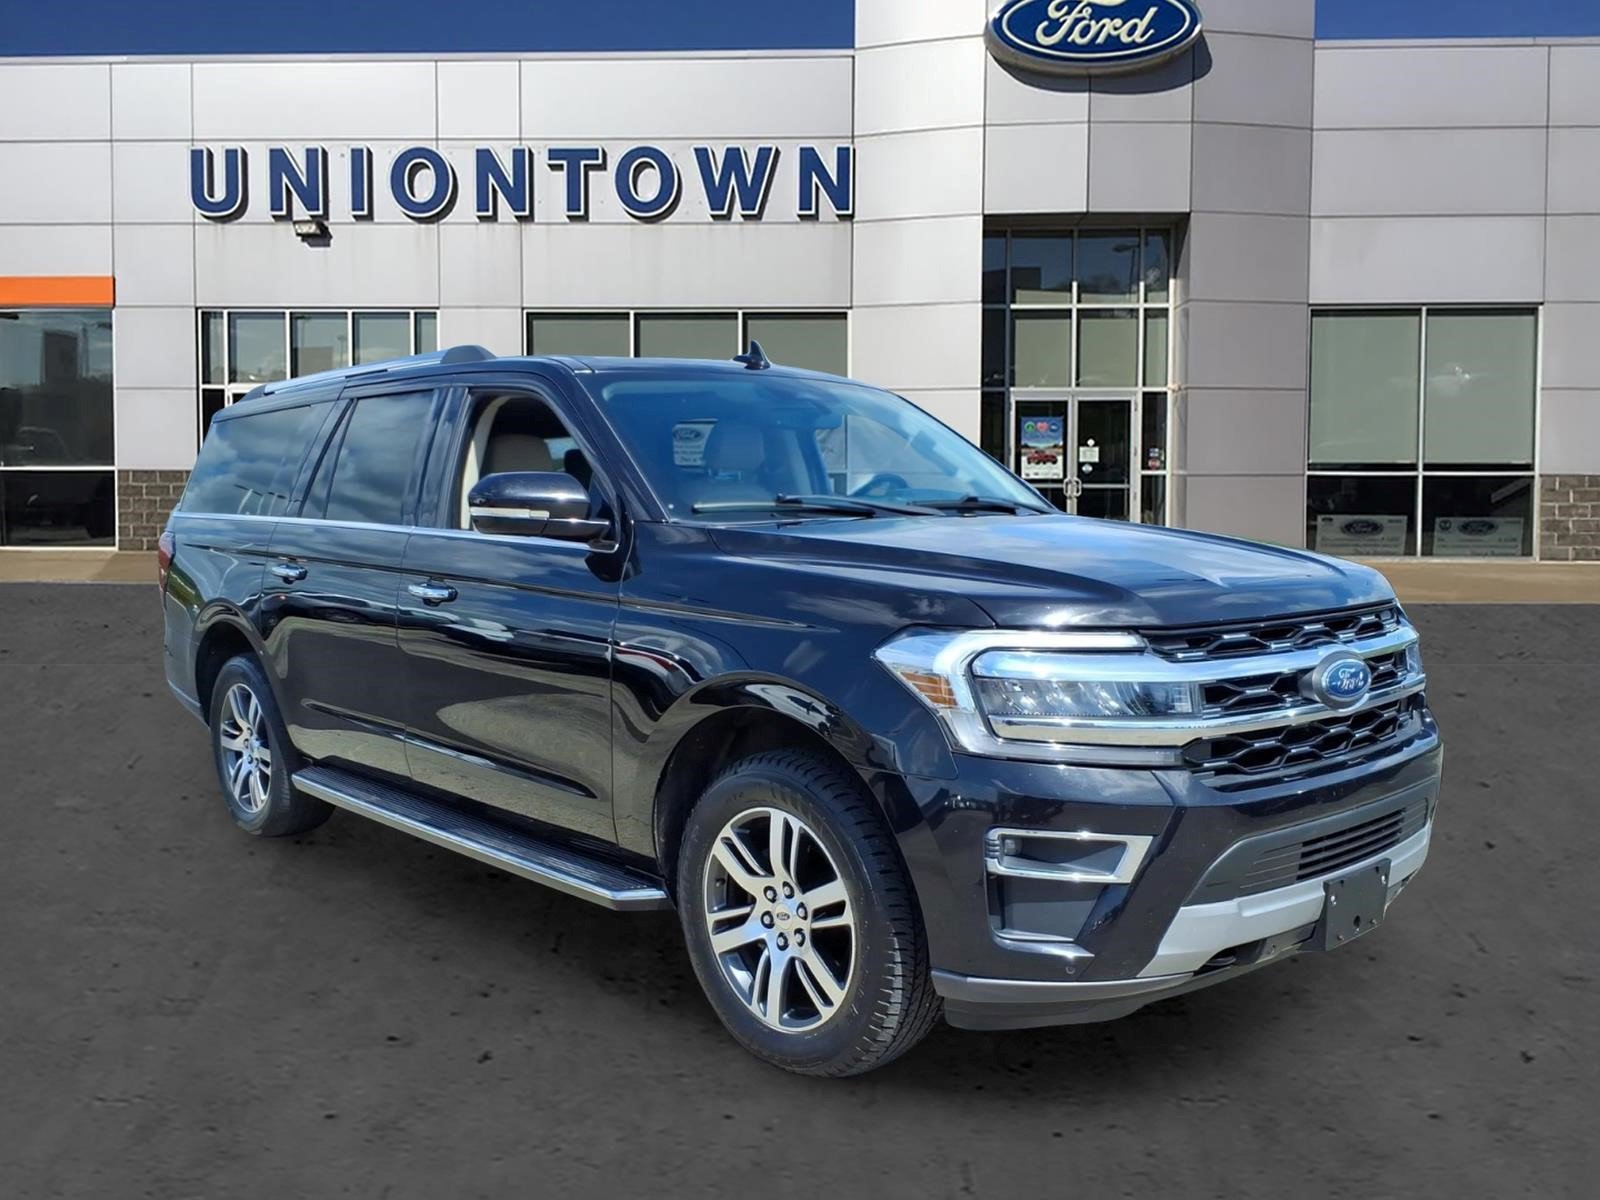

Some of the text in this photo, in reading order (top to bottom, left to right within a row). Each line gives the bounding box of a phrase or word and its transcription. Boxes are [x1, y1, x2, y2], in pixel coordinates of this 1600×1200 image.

[1035, 0, 1159, 46] Ford
[190, 144, 854, 220] UNIONTOWN
[1331, 667, 1365, 690] Ford
